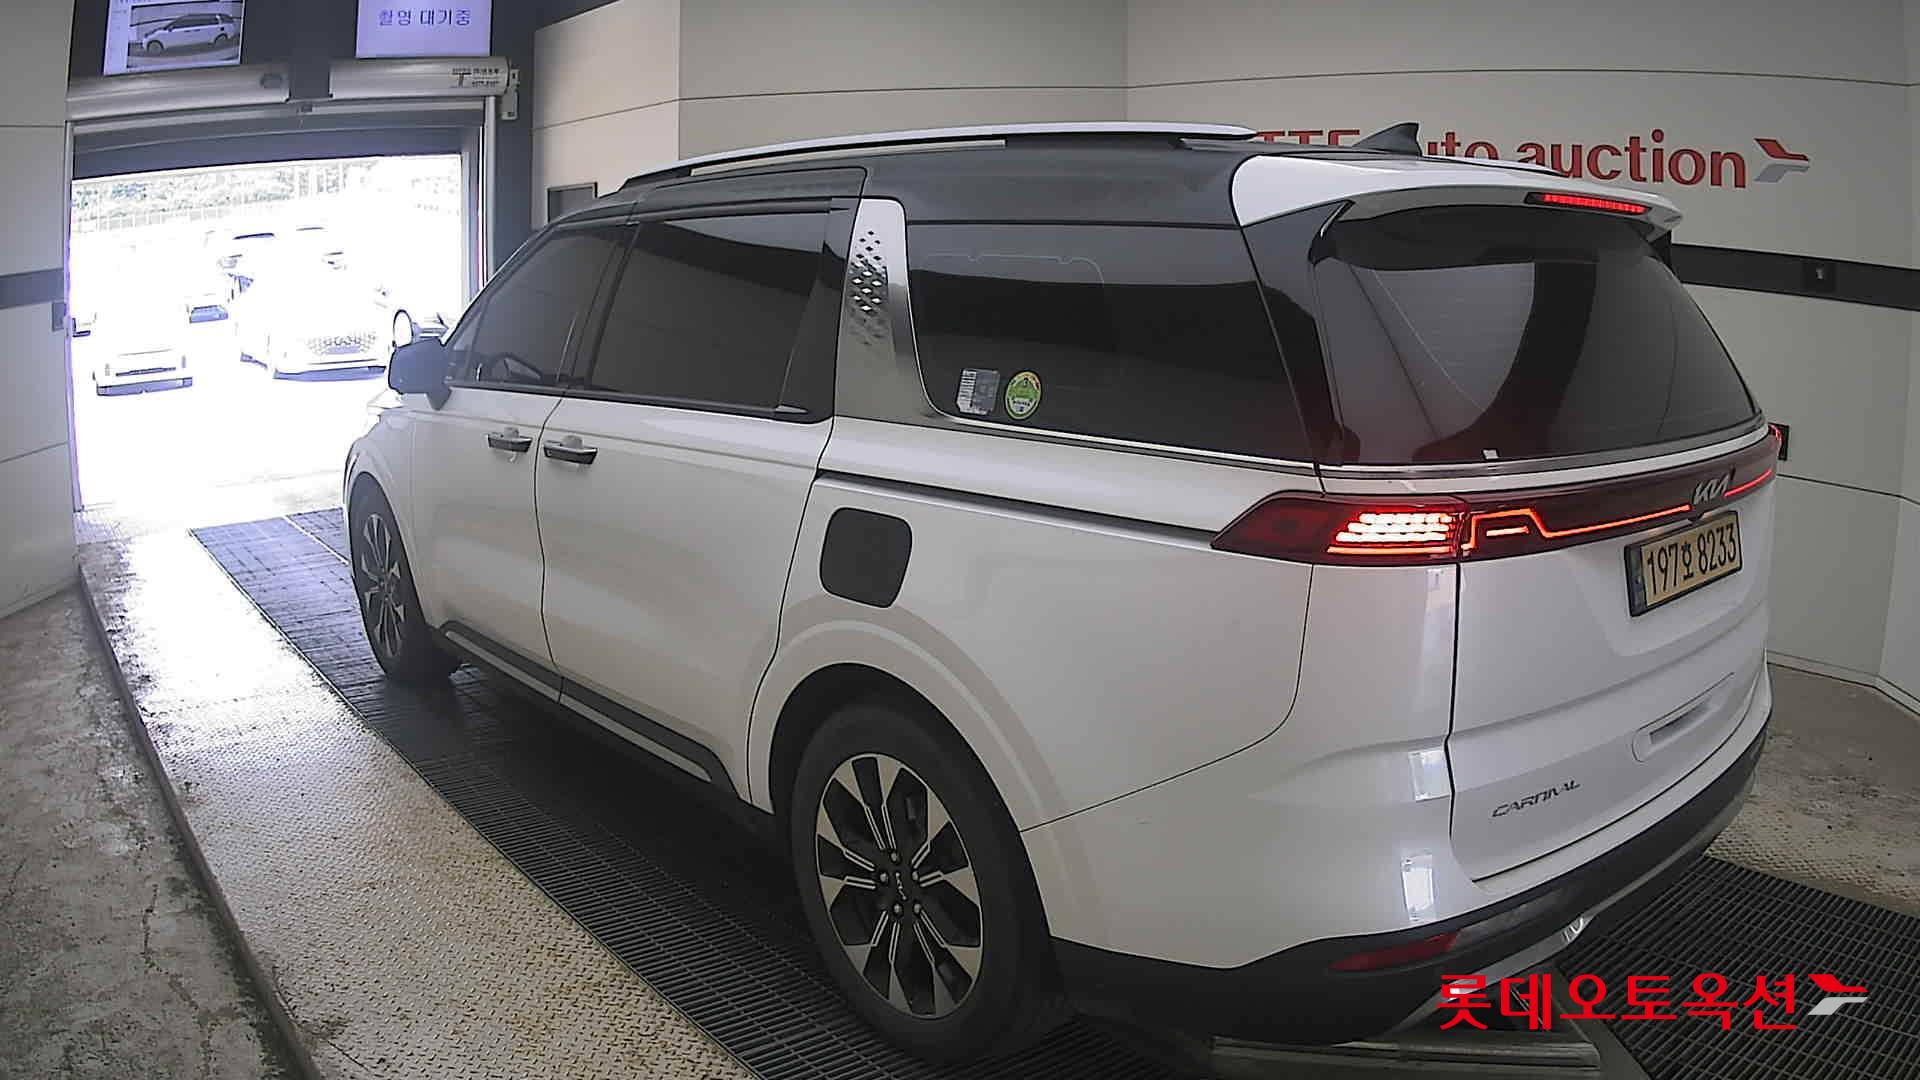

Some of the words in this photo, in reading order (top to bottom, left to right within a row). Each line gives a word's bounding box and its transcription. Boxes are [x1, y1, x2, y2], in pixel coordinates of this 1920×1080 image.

[1516, 129, 1746, 188] auction
[1647, 541, 1694, 595] 197호
[1697, 523, 1737, 575] 8233
